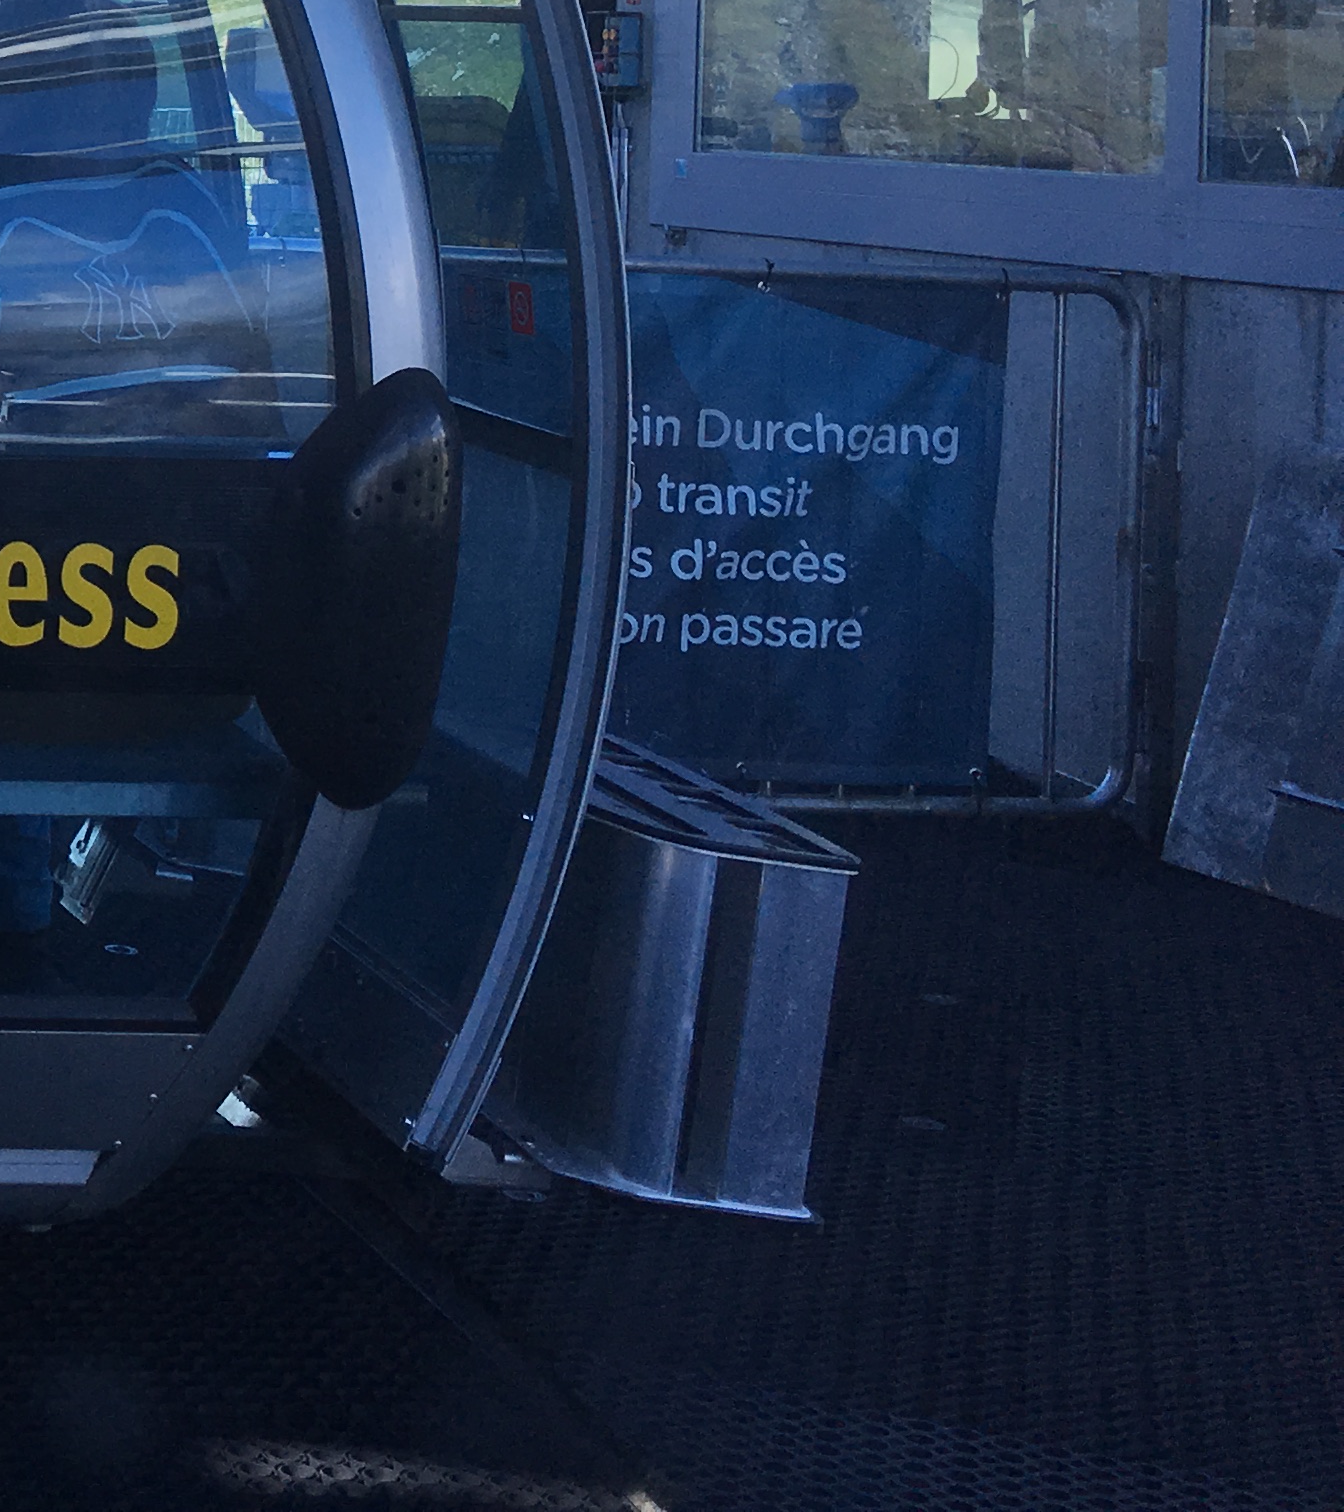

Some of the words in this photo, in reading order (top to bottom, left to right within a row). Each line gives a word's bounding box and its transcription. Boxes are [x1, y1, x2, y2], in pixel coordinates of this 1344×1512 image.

[697, 407, 960, 465] Durchgang
[657, 472, 813, 519] transit
[670, 538, 847, 585] d'accès
[680, 610, 863, 653] passare
